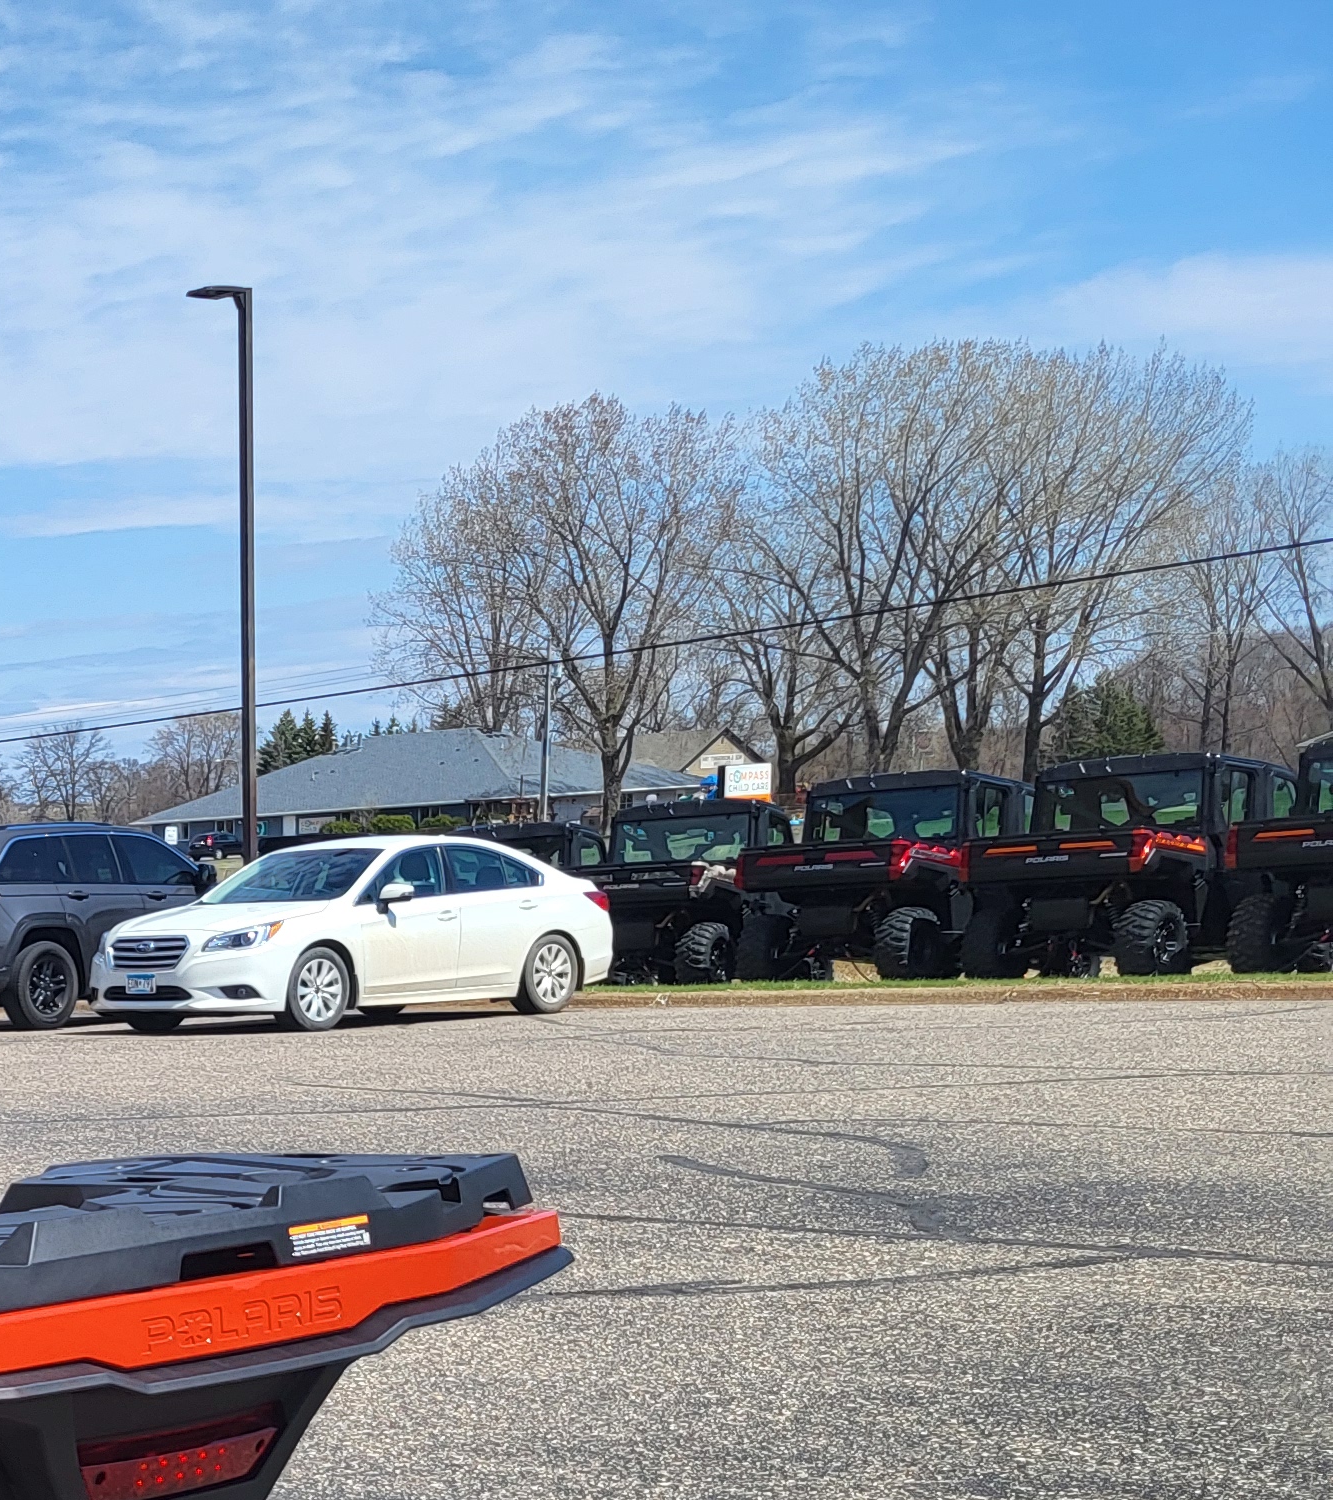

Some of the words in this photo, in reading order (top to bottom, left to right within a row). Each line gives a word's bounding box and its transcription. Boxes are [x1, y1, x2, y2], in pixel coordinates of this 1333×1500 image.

[728, 770, 769, 783] COMPASS
[728, 783, 749, 793] CHILD
[751, 782, 769, 791] CARE
[1024, 854, 1069, 864] POLARIS
[794, 864, 833, 872] POLARIS
[140, 1285, 343, 1356] POLARIS
